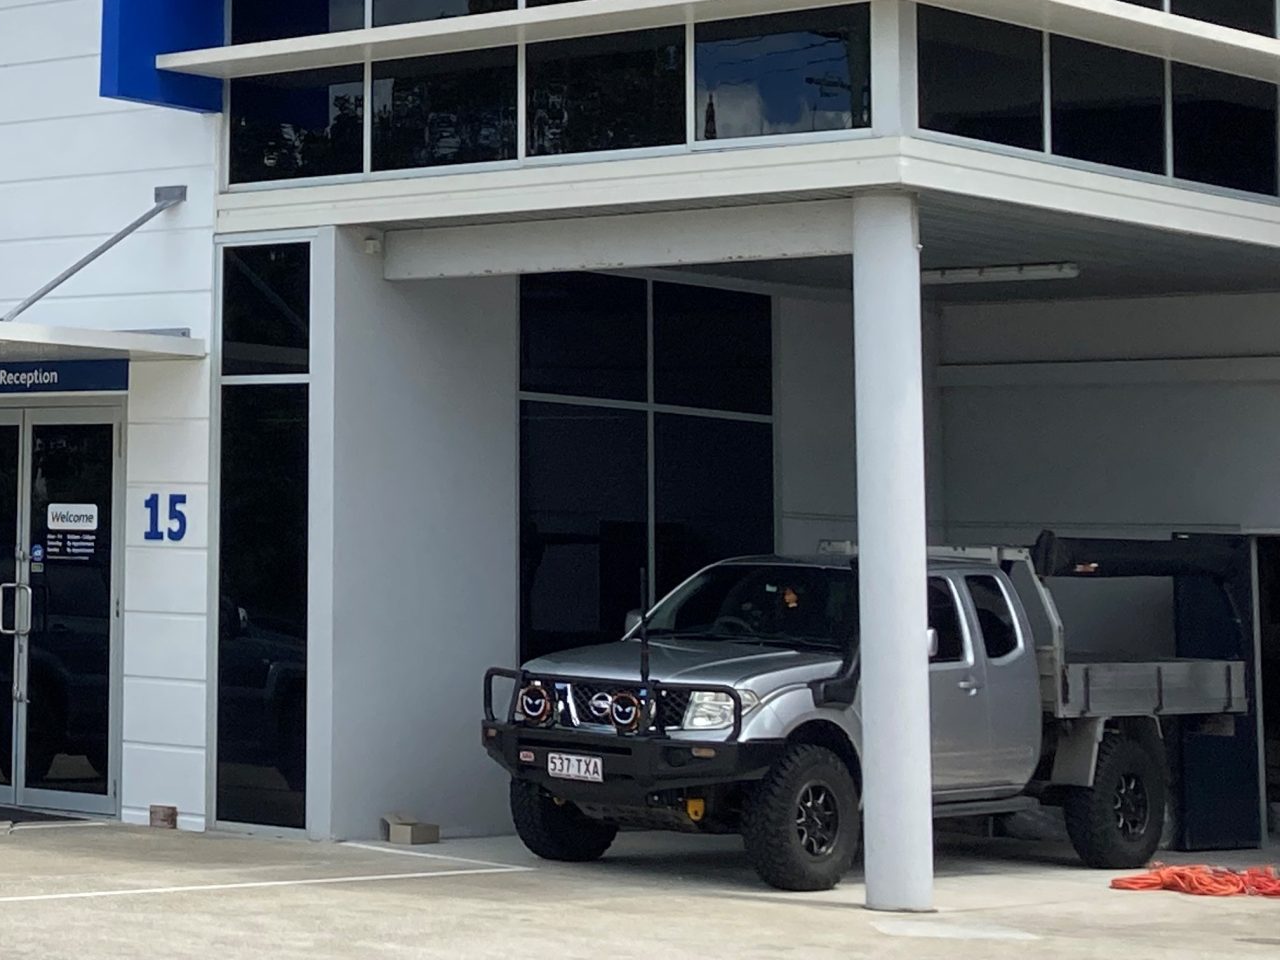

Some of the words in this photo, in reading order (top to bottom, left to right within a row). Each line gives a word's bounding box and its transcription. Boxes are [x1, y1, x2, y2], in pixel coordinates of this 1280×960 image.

[0, 369, 58, 388] Reception
[51, 510, 94, 524] Welcome
[144, 493, 187, 541] 15
[549, 756, 572, 773] 537
[576, 758, 600, 777] TXA
